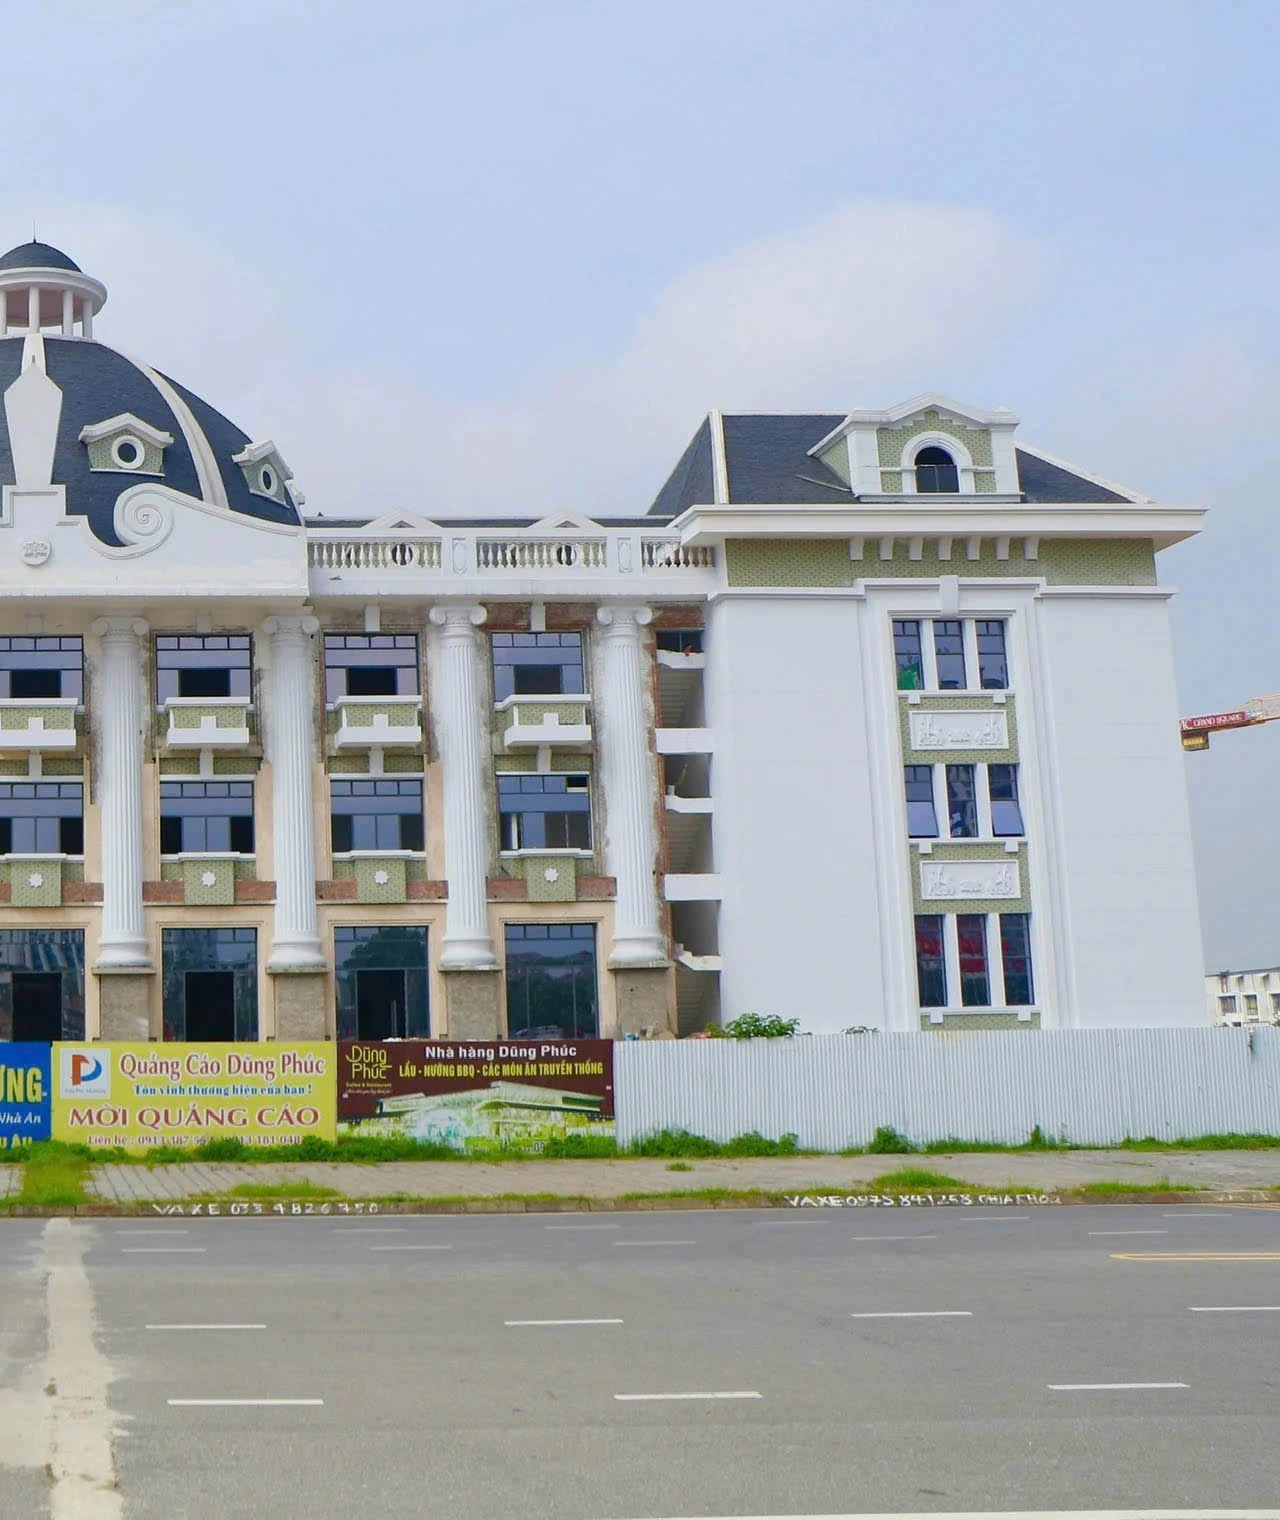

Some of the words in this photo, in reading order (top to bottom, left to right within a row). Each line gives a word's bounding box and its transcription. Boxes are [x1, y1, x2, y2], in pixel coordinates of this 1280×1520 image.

[425, 1046, 454, 1059] Nhà
[458, 1046, 494, 1060] hàng
[499, 1046, 537, 1060] Dũng
[541, 1044, 577, 1058] Phúc
[120, 1053, 180, 1081] Quảng
[186, 1053, 221, 1075] Cáo
[281, 1053, 325, 1075] Phúc
[351, 1063, 387, 1080] Phúc
[456, 1064, 475, 1078] BBQ
[70, 1104, 128, 1126] MỜI
[257, 1103, 320, 1126] CÁO
